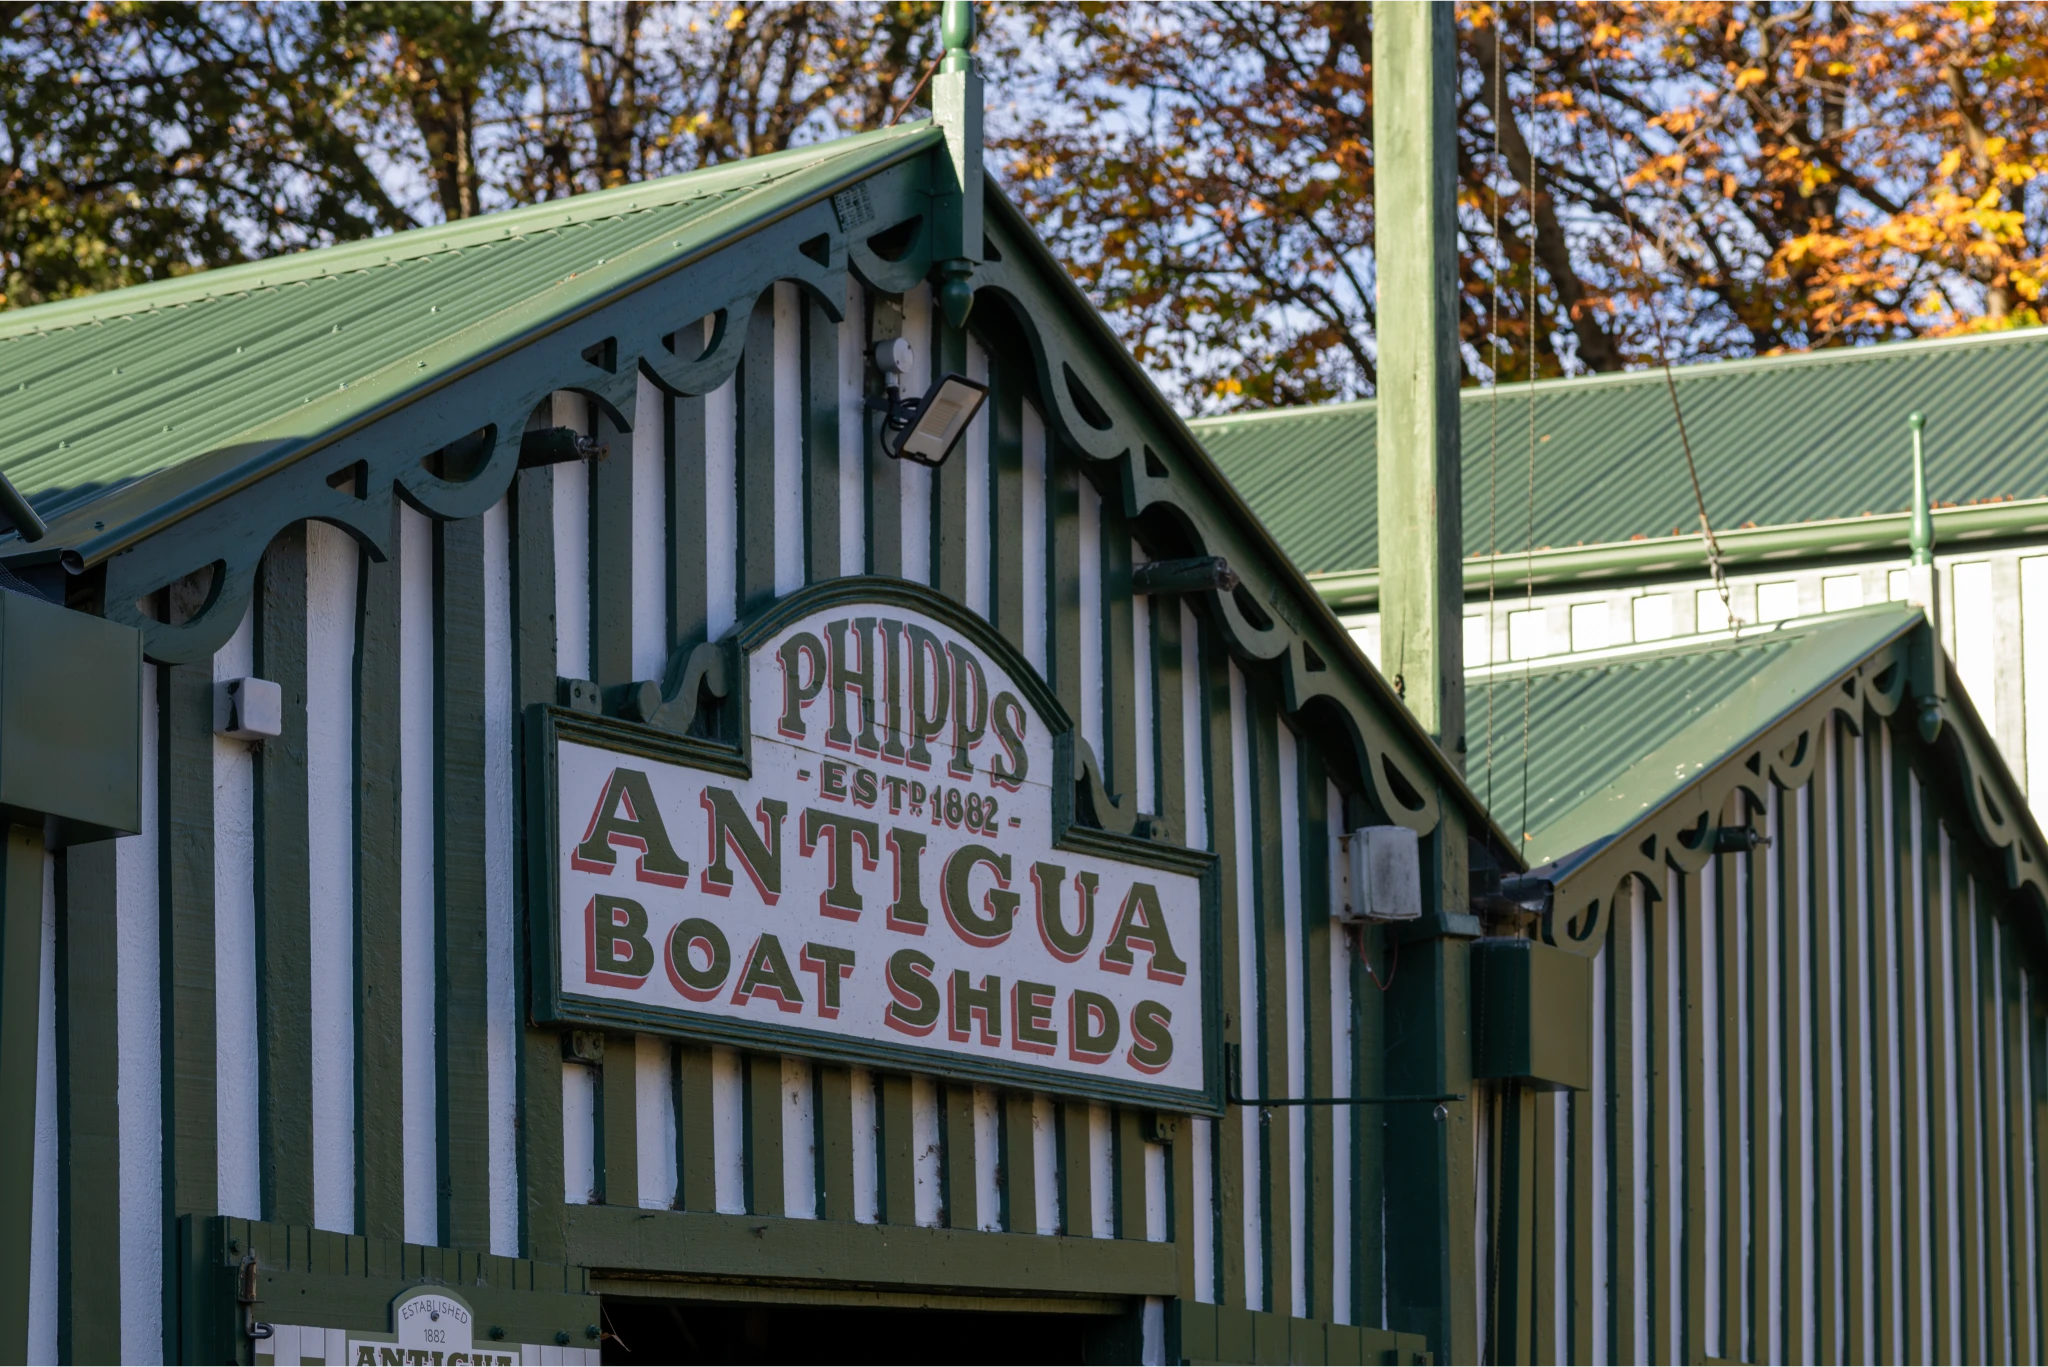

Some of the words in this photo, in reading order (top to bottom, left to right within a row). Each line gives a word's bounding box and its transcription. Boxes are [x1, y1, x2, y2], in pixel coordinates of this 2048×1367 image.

[777, 617, 1029, 792] PHIPPS
[571, 768, 1187, 985] ANTIGUA
[586, 894, 856, 1019] BOAT
[885, 948, 1174, 1075] SHEDS
[403, 1300, 468, 1324] ESTABLISHED
[424, 1329, 446, 1344] 1882
